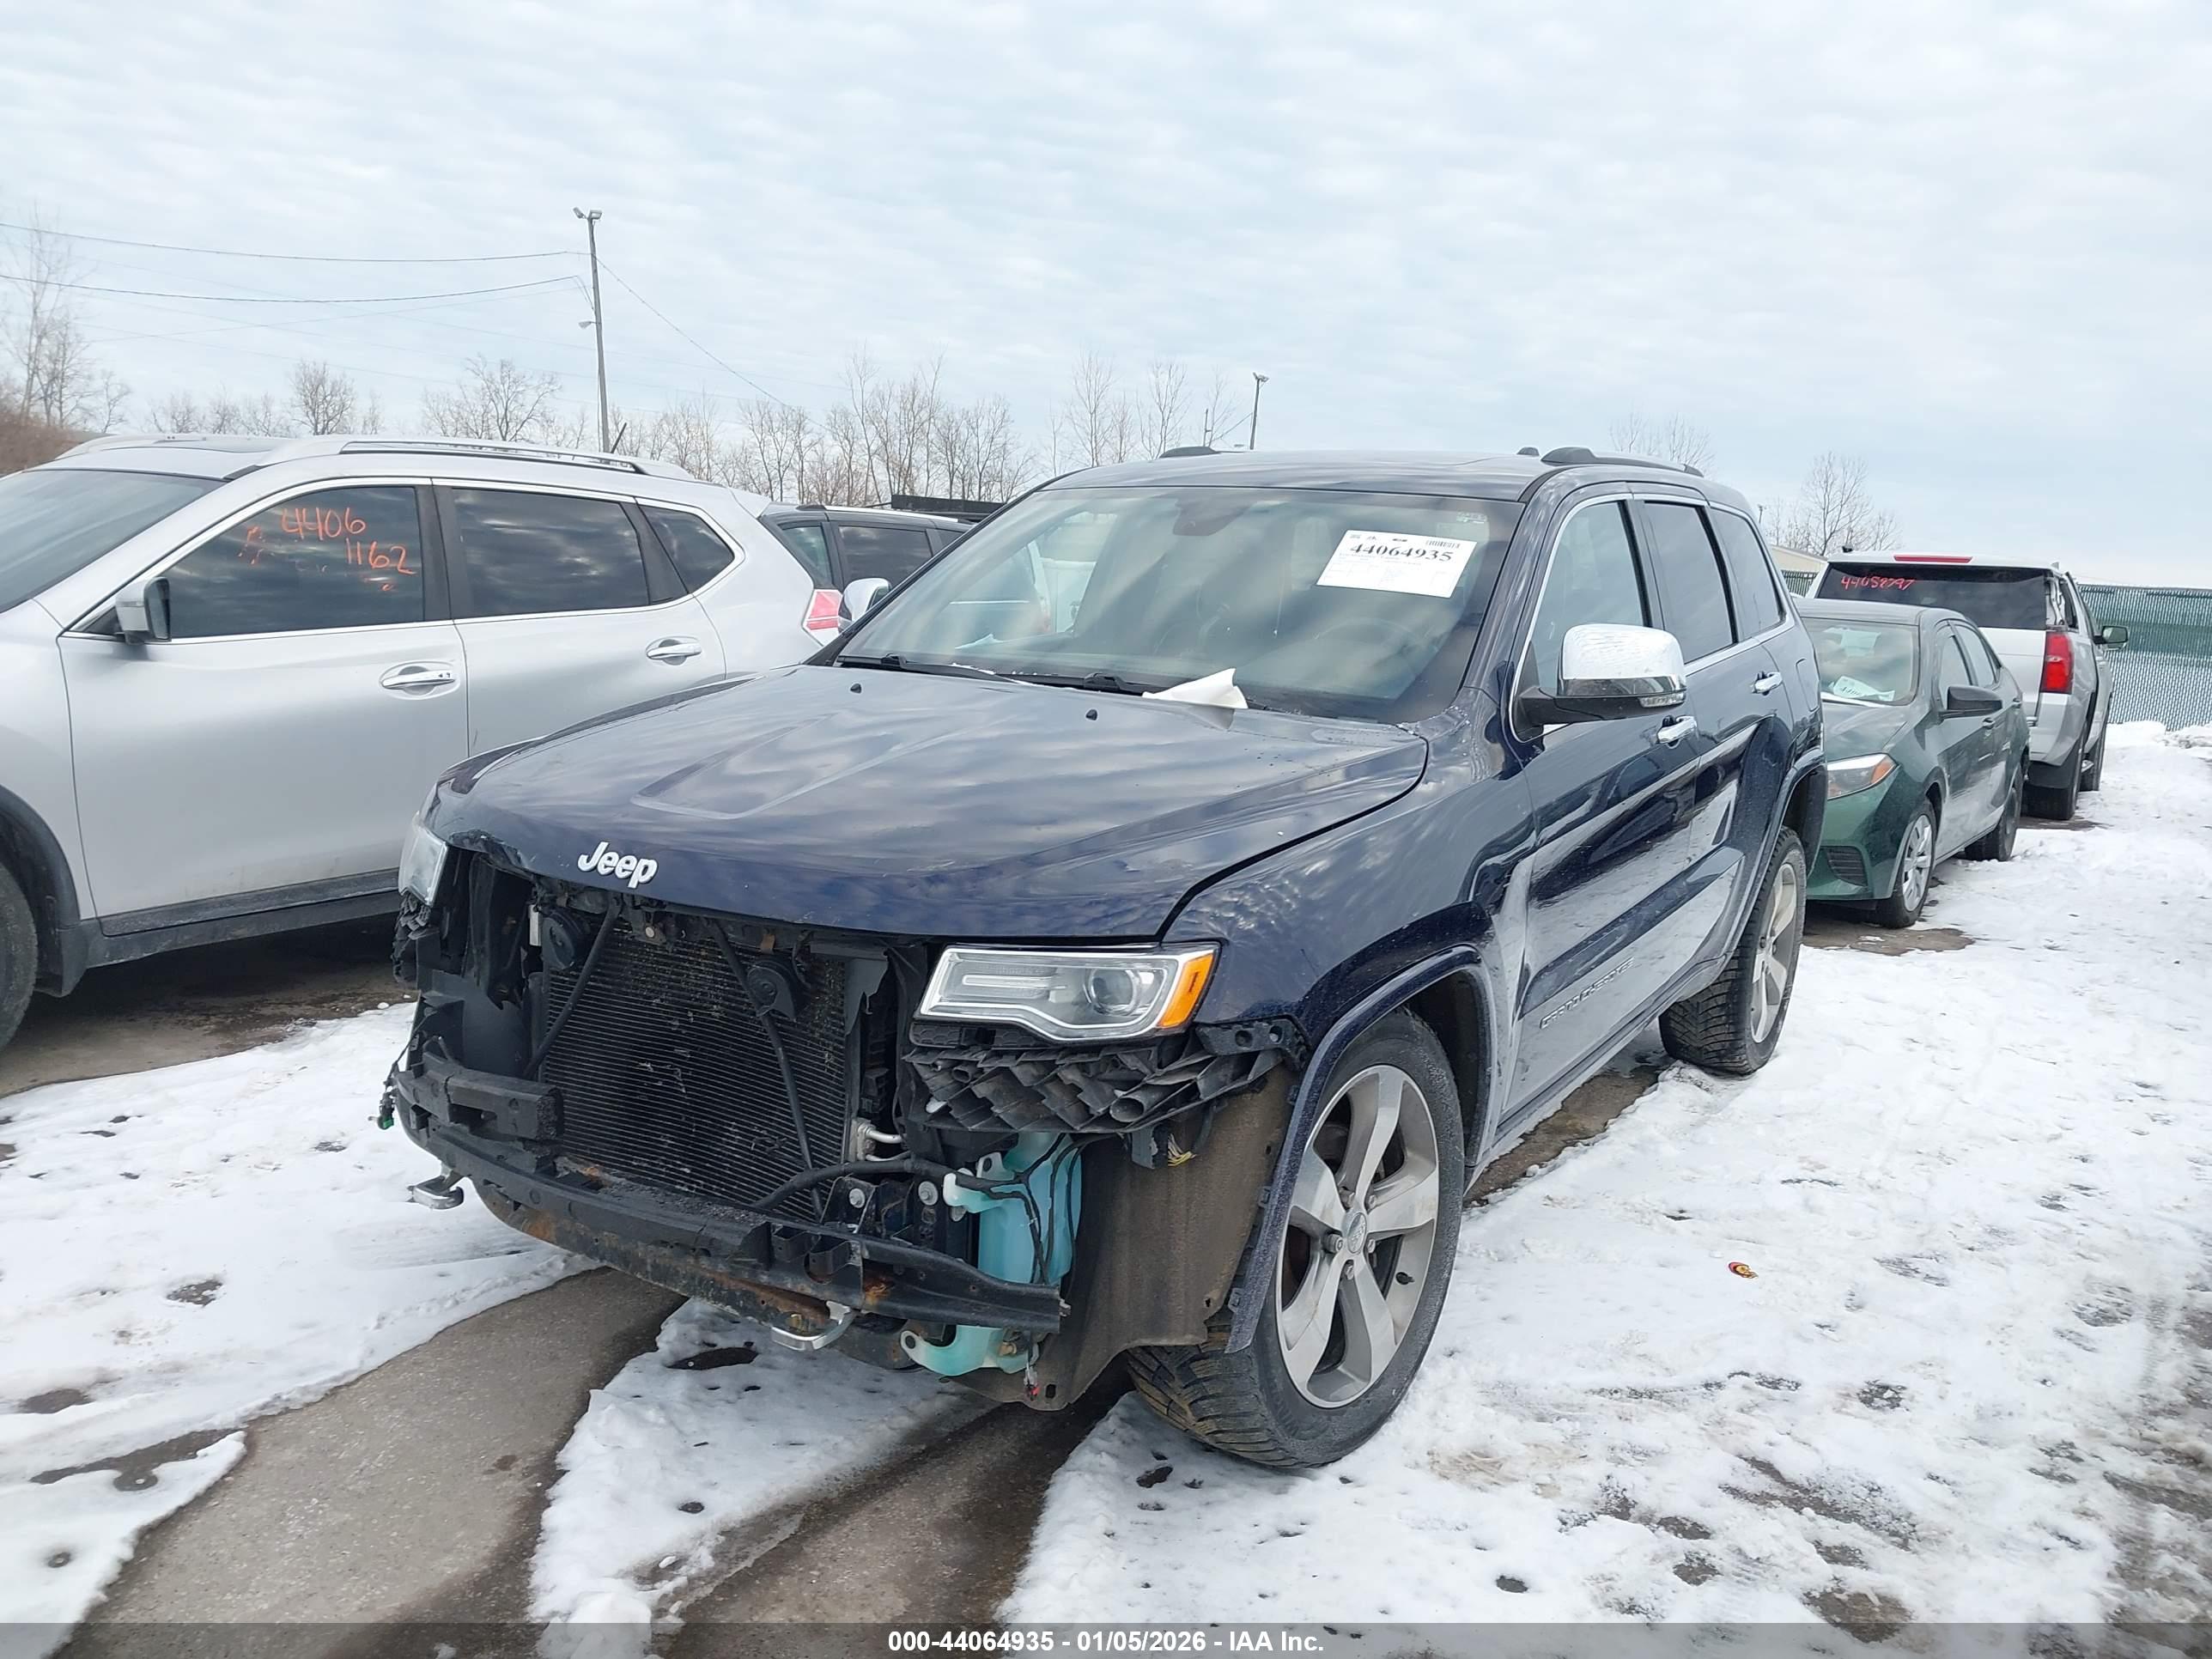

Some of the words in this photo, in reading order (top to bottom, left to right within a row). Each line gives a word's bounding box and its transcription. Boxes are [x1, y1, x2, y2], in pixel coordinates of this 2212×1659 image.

[280, 507, 367, 541] 4406
[345, 538, 417, 575] 1162
[1350, 543, 1455, 562] 44064935
[577, 841, 659, 890] Jeep
